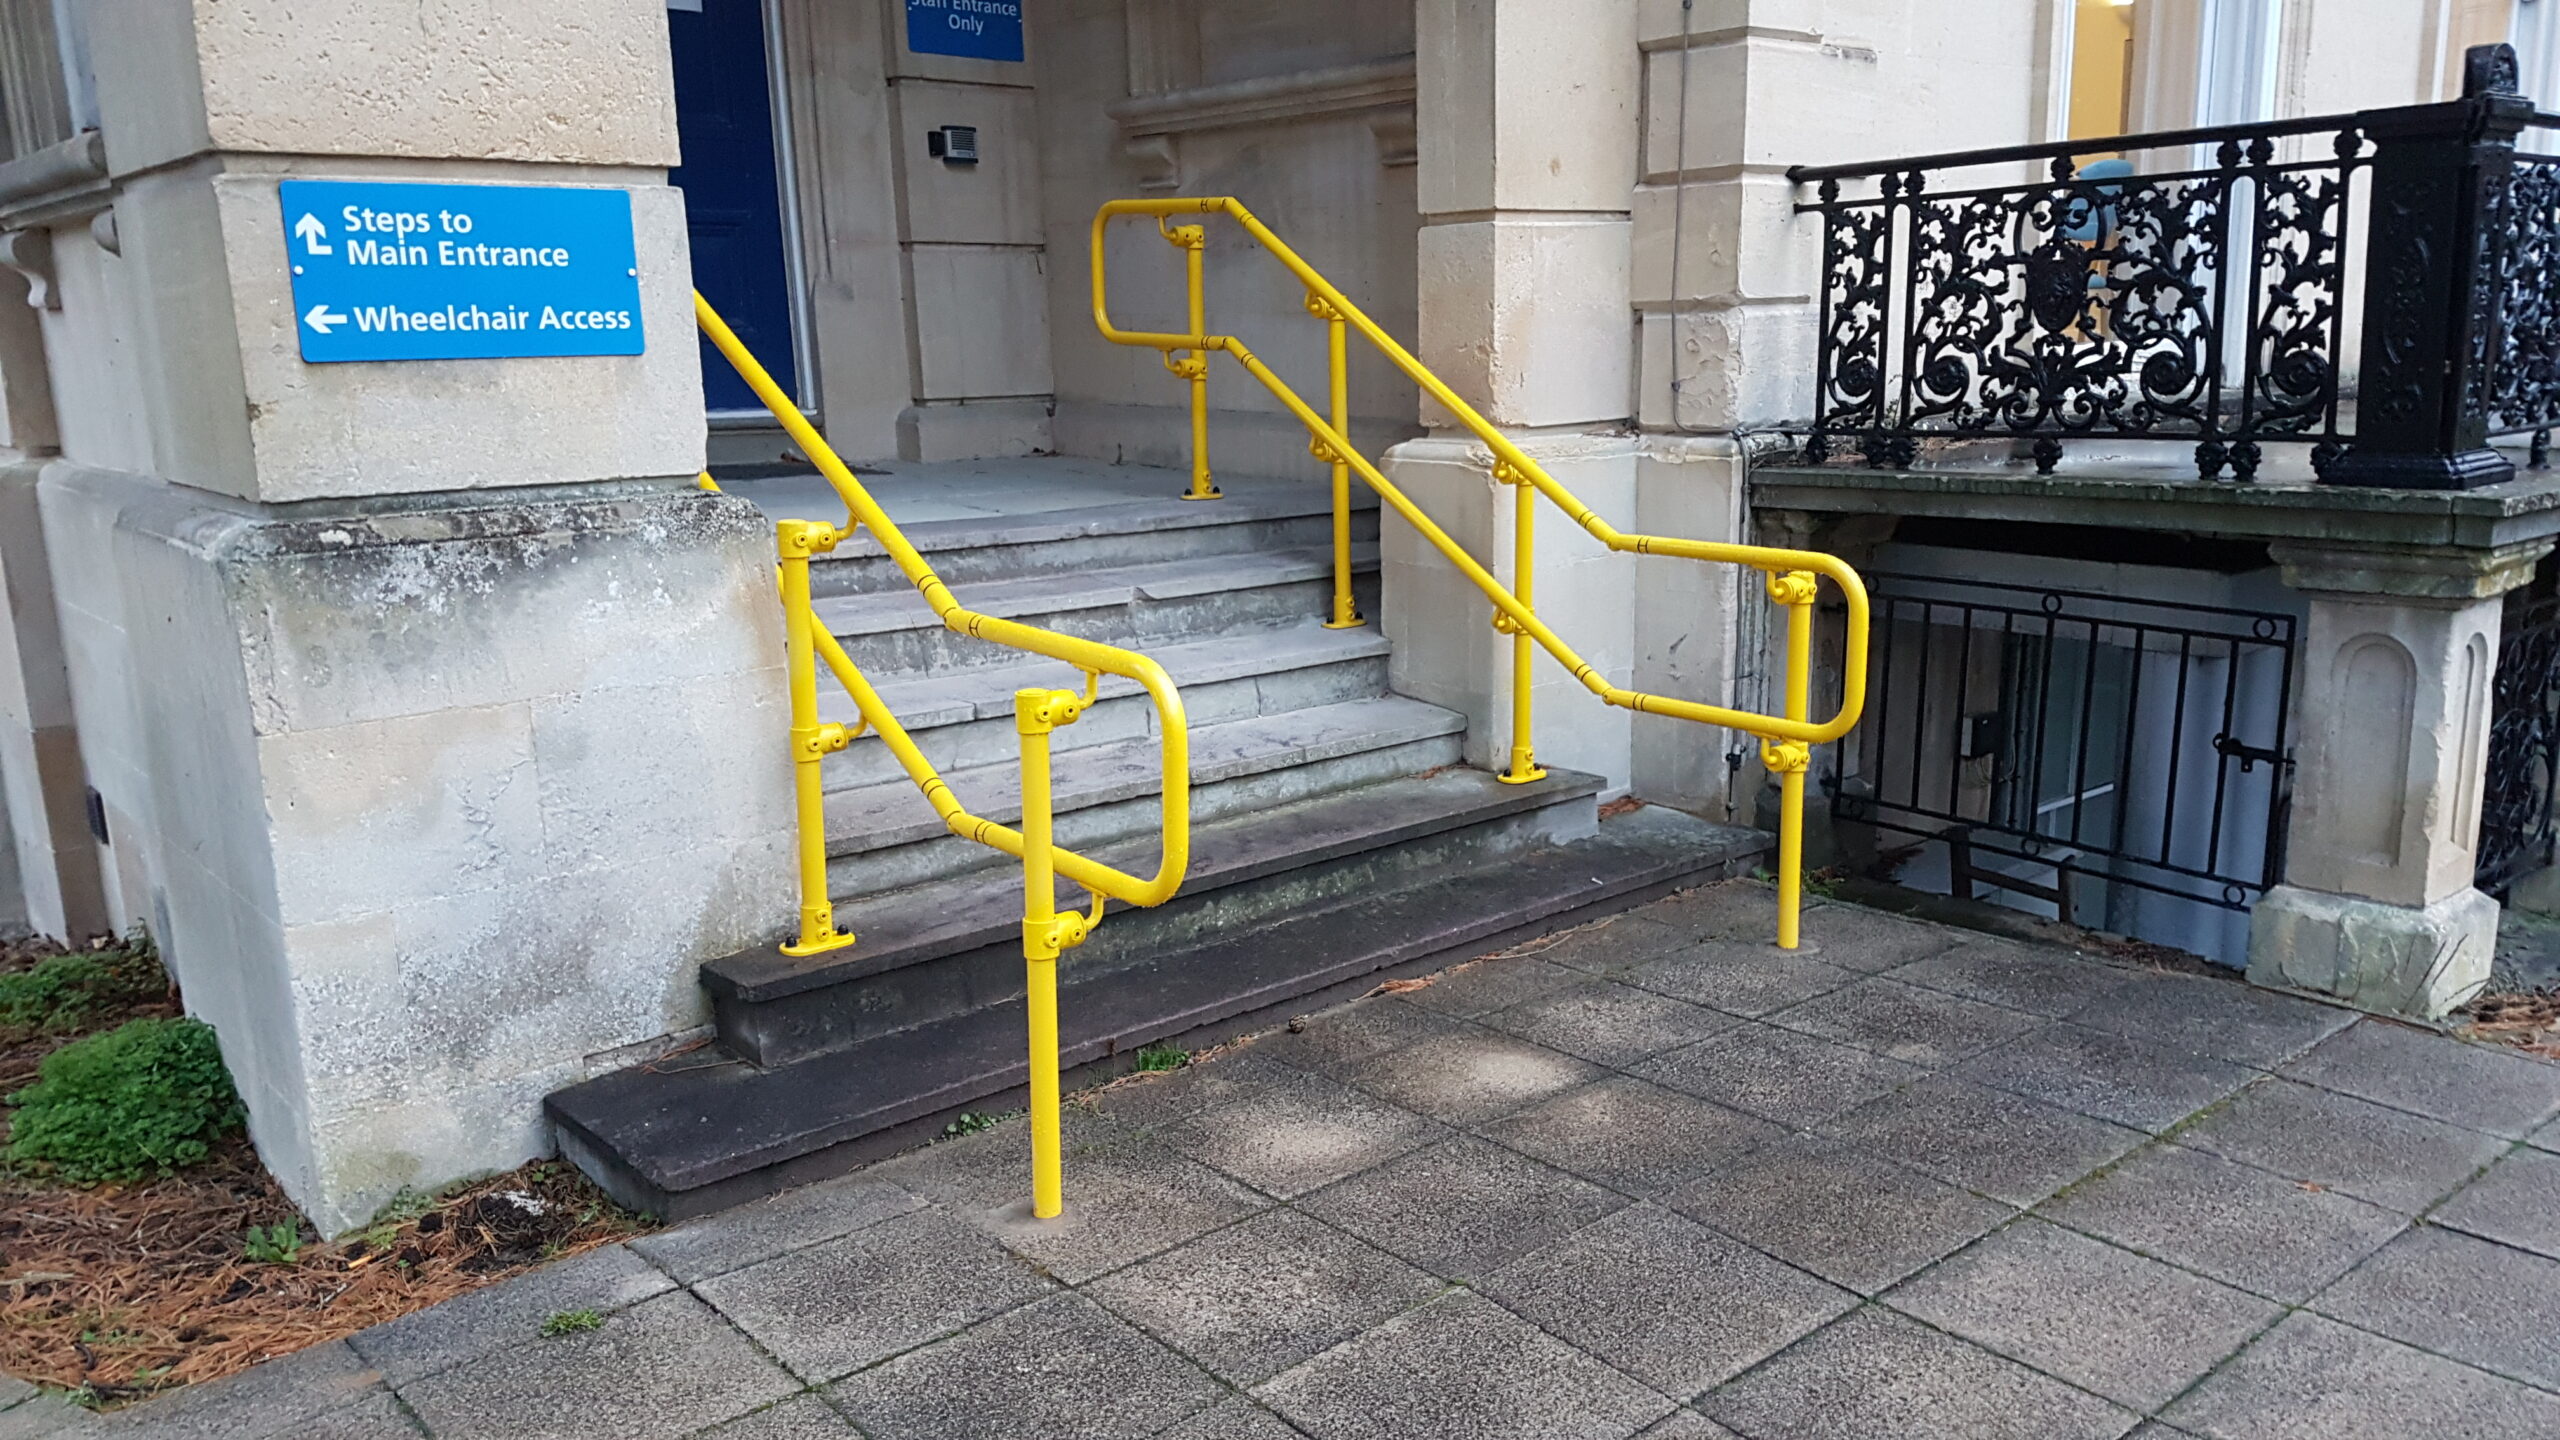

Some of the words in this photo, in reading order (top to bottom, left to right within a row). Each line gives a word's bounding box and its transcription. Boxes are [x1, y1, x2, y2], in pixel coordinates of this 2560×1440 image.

[948, 14, 984, 36] Only
[342, 205, 430, 239] Steps
[438, 209, 473, 234] to
[347, 239, 428, 266] Main
[438, 240, 569, 267] Entrance
[353, 304, 530, 332] Wheelchair
[539, 305, 631, 331] Access
